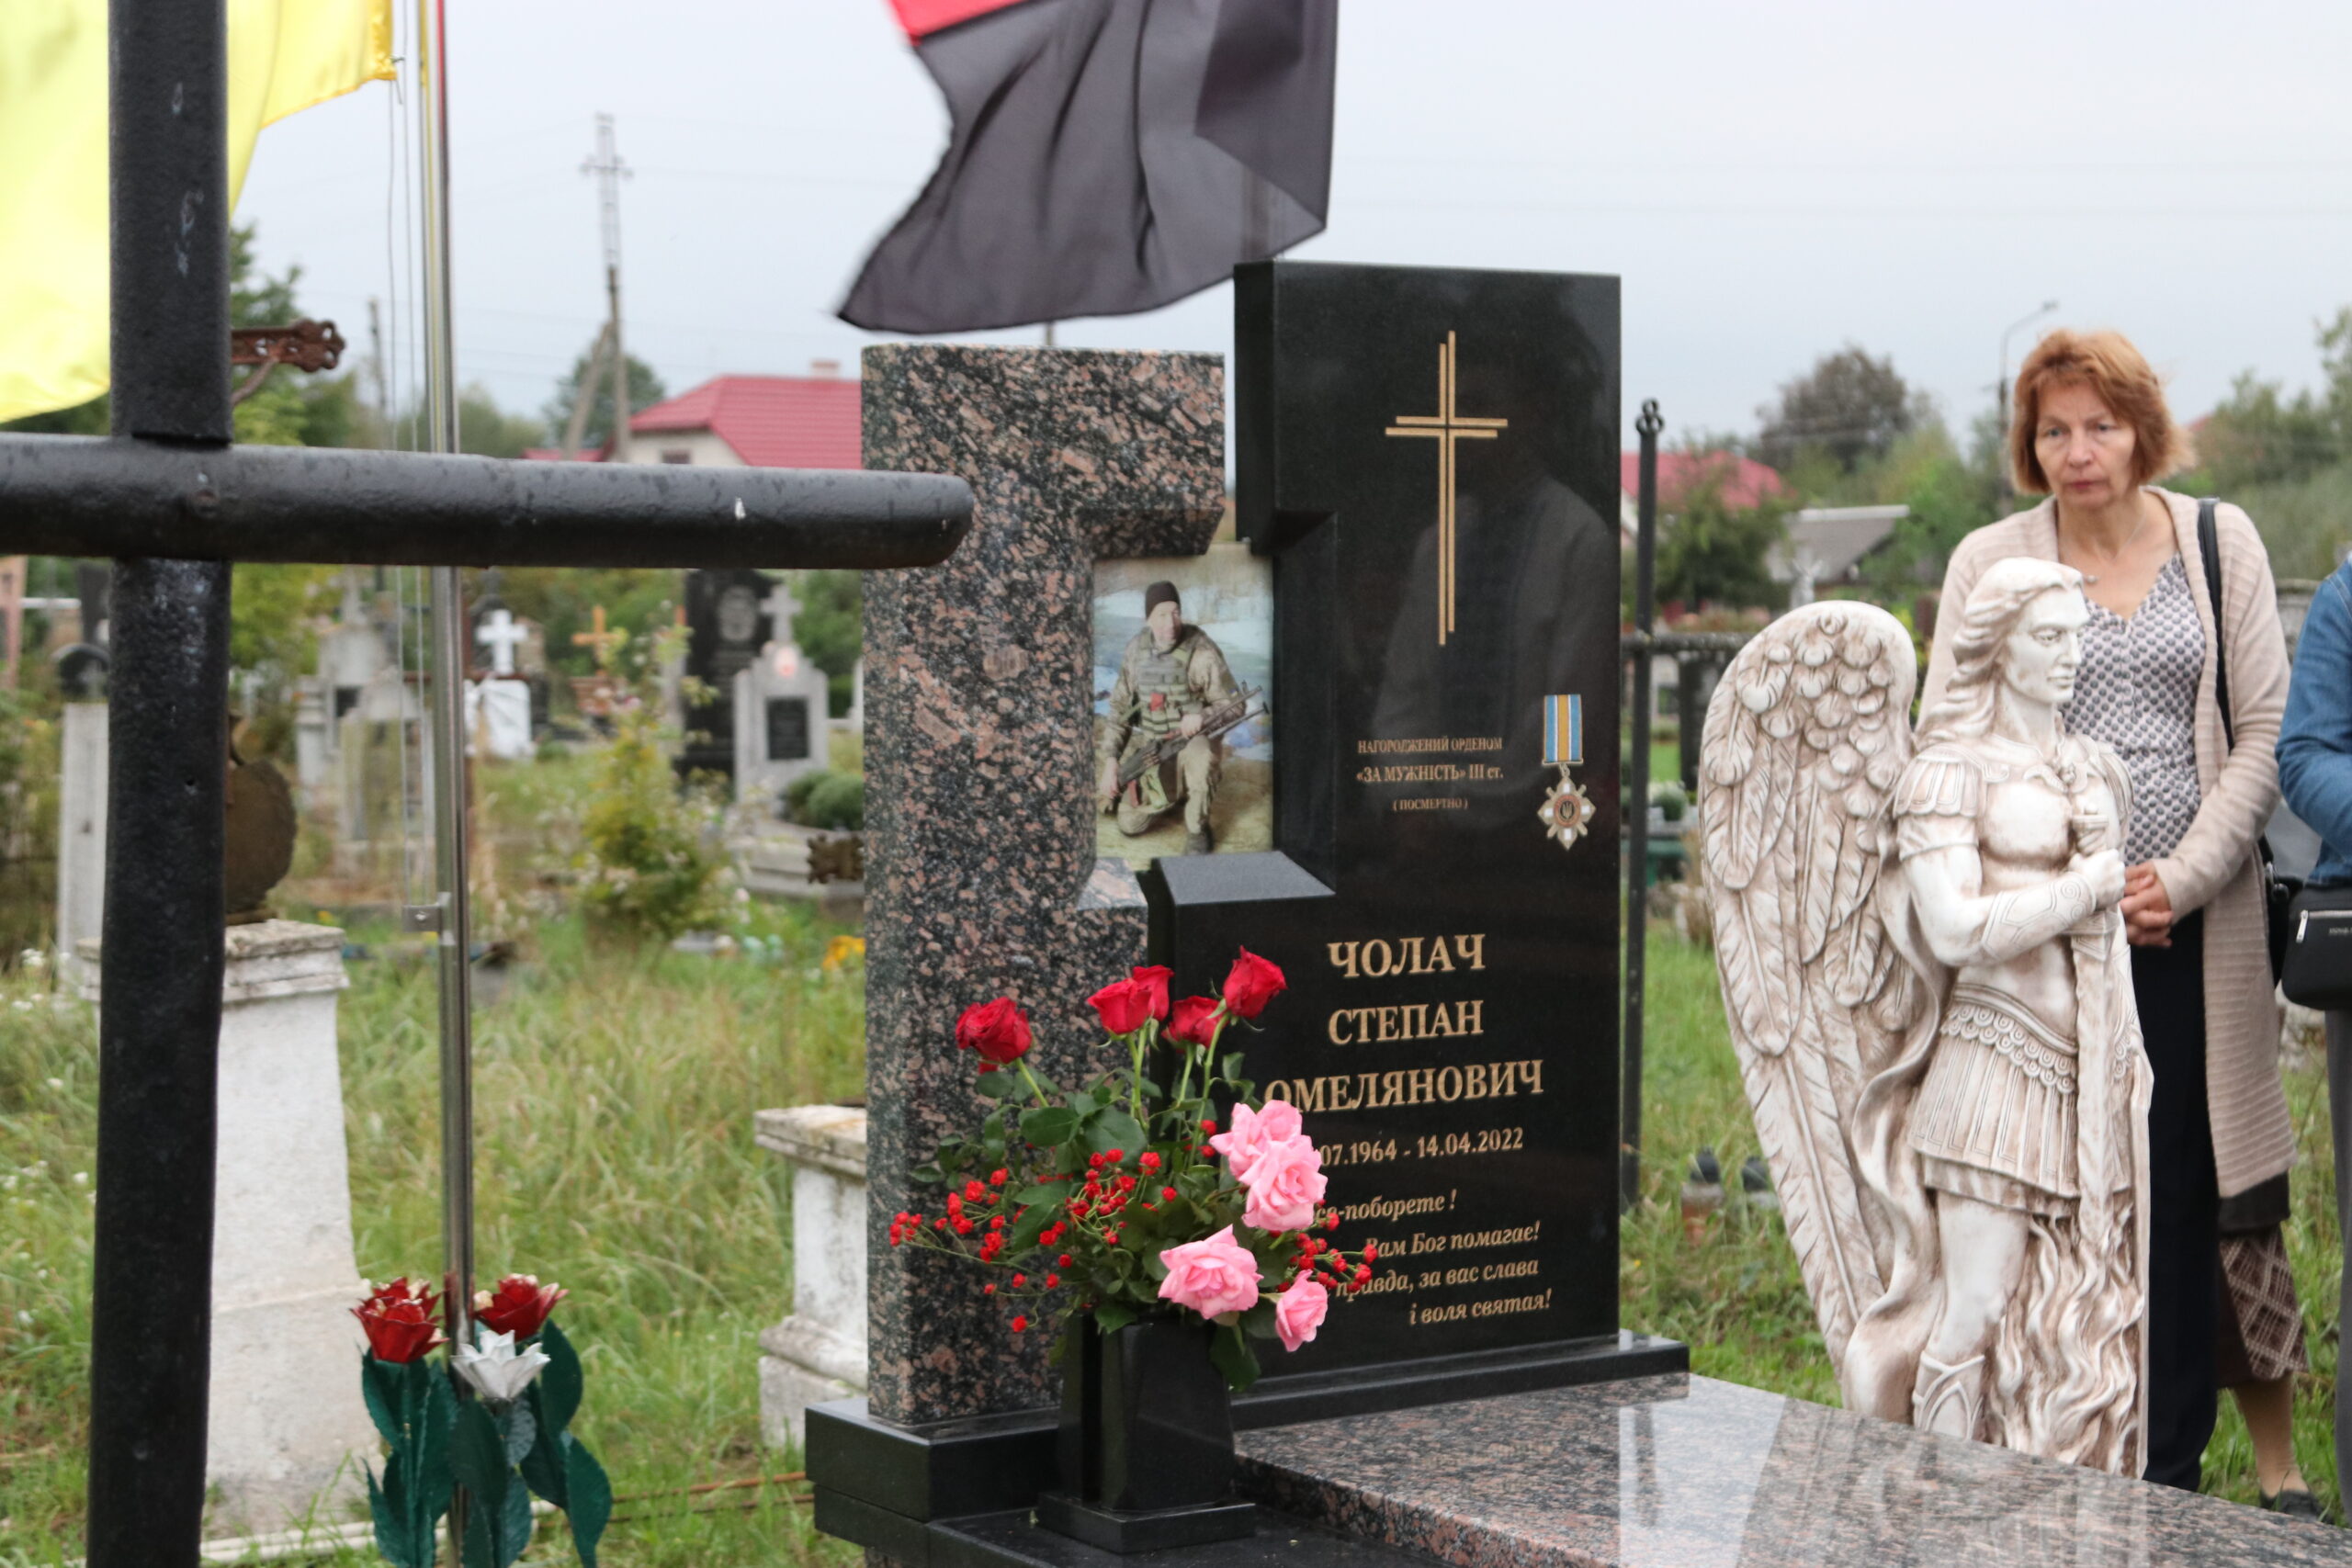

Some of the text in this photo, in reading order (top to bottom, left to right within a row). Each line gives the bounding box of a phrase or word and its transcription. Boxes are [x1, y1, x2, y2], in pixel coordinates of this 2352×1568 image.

[1357, 737, 1503, 753] НАГОРОДЖЕНИЙ ОРДЕНОМ
[1487, 765, 1504, 778] ст.
[1327, 933, 1487, 977] ЧОЛАЧ
[1328, 999, 1485, 1045] СТЕПАН
[1264, 1059, 1544, 1113] ОМЕЛЯНОВИЧ
[1319, 1138, 1397, 1167] 07.1964
[1417, 1127, 1523, 1159] 14.04.2022
[1409, 1232, 1447, 1255] Бог
[1419, 1270, 1442, 1288] за
[1445, 1265, 1479, 1285] вас
[1482, 1258, 1539, 1280] слава
[1420, 1303, 1467, 1325] воля
[1471, 1288, 1552, 1317] святая!
